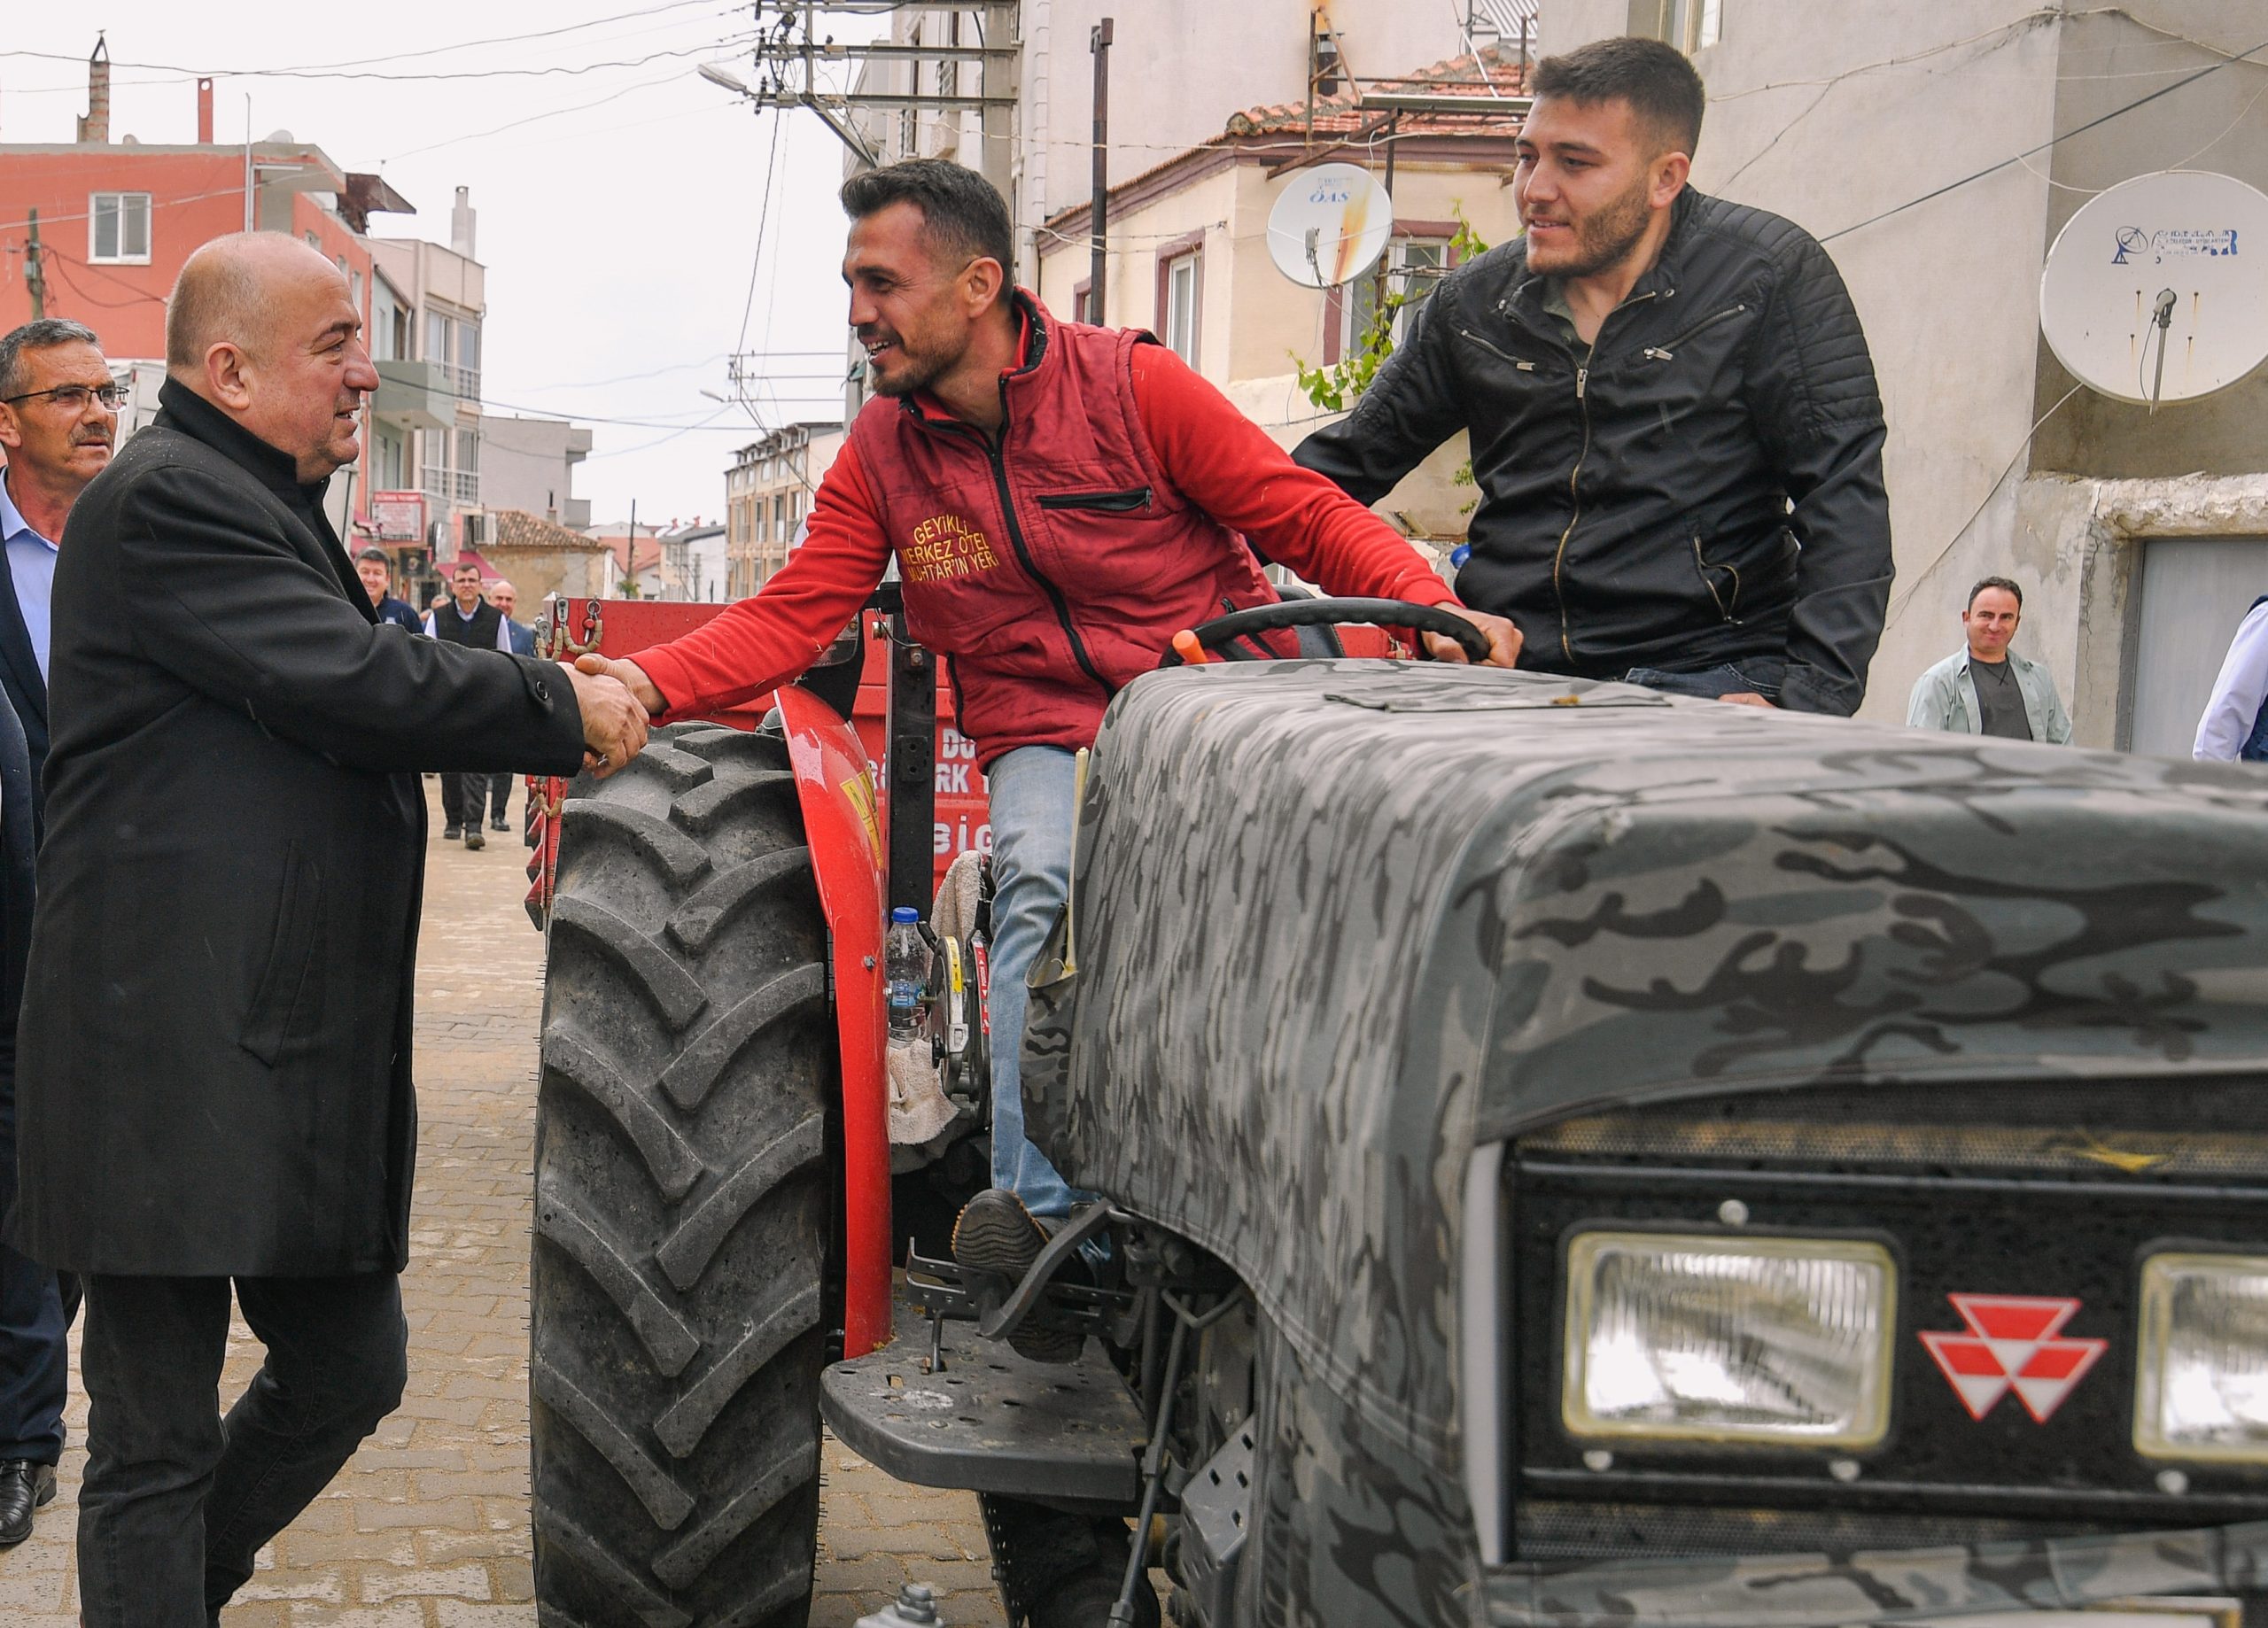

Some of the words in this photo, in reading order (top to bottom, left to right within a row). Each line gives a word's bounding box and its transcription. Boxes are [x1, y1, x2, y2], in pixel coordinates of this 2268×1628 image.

[913, 514, 967, 545] GEYİKLİ
[900, 539, 954, 565] MERKEZ
[959, 532, 990, 554] OTEL
[969, 550, 999, 571] YERİ
